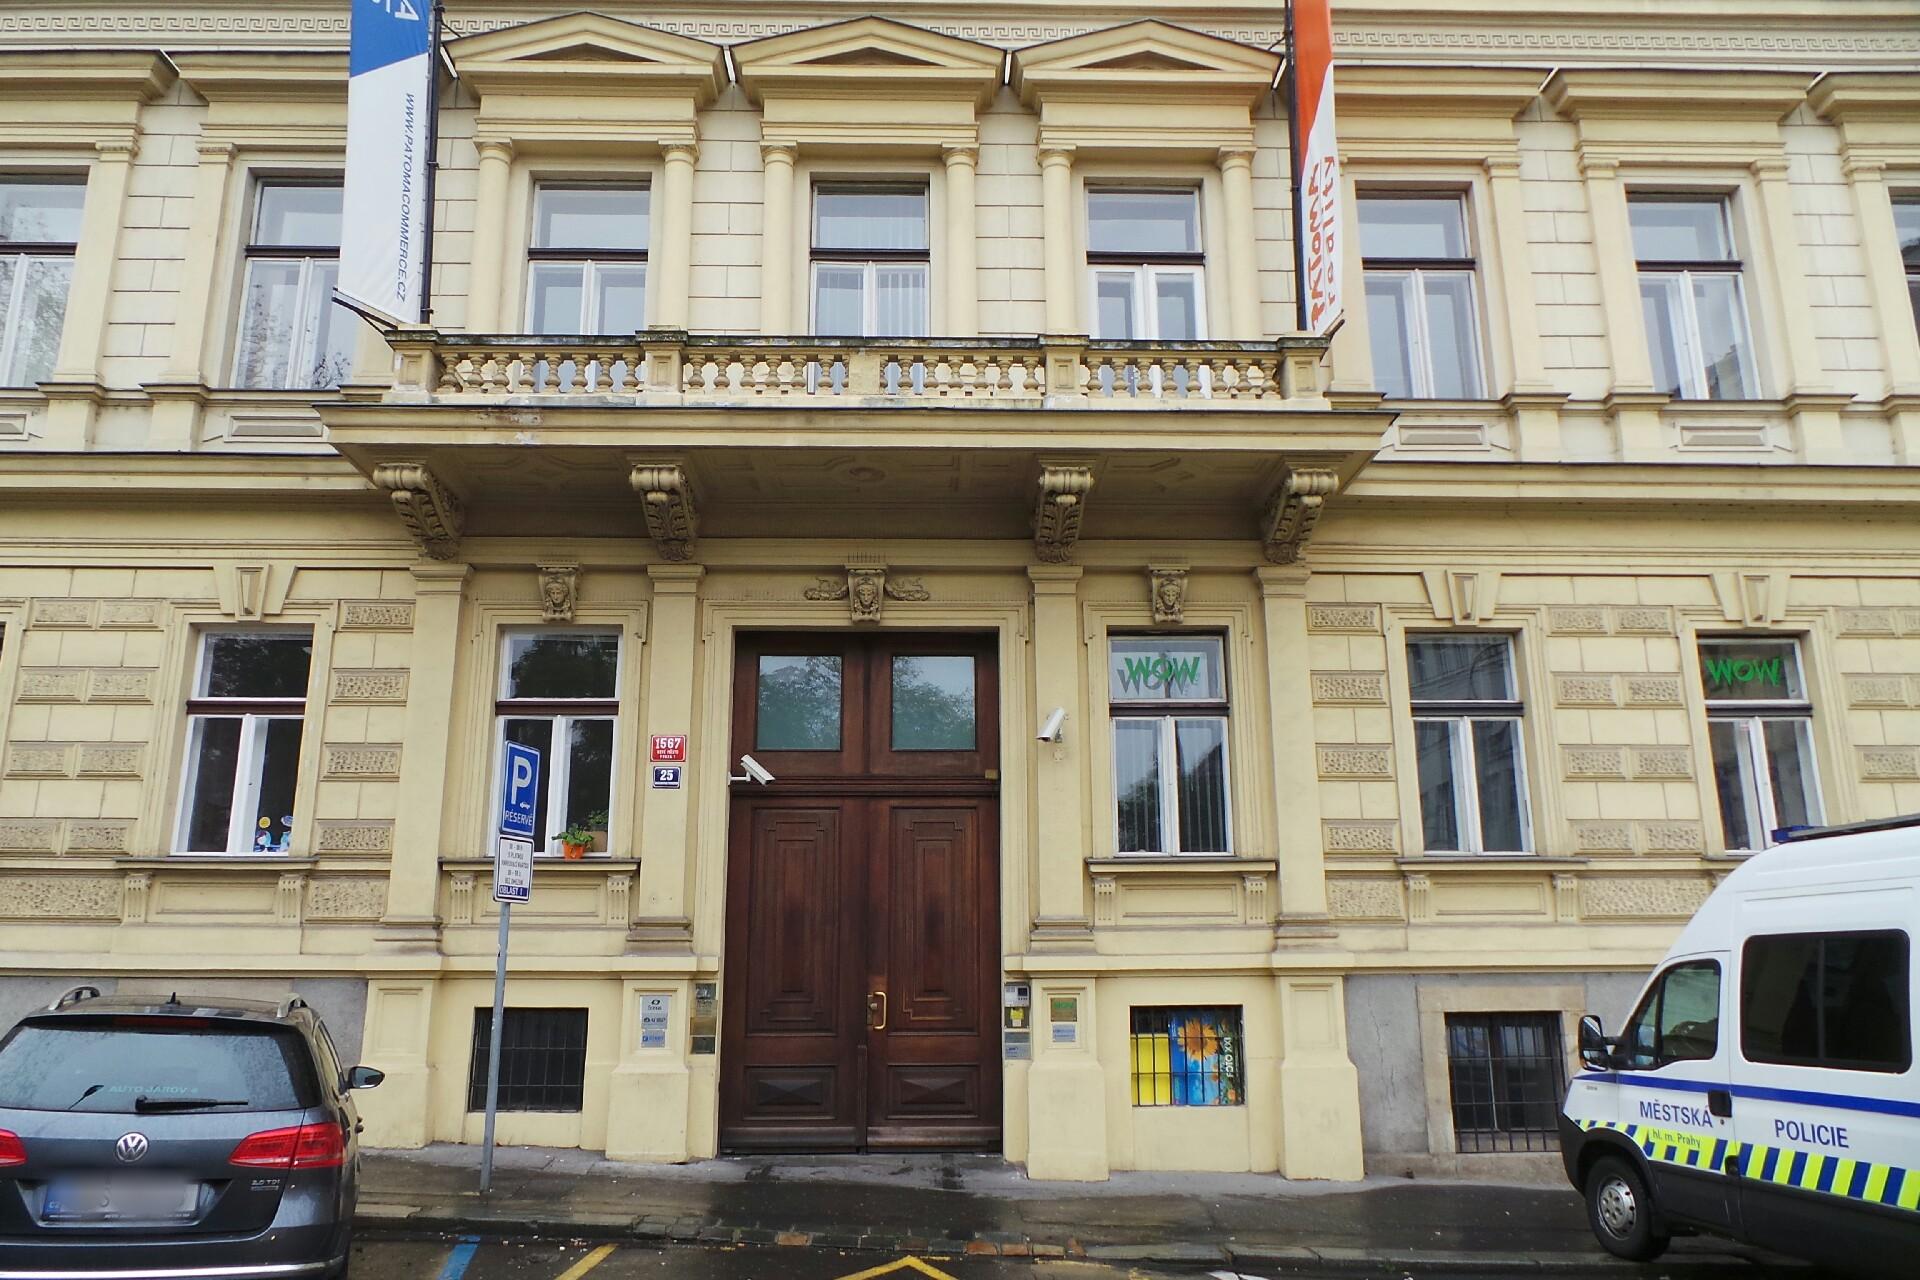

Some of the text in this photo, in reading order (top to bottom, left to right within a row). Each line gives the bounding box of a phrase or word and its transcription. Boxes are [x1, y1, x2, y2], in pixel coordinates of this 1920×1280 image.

[396, 92, 415, 303] WWW.PATOMACOMMERCE.CZ
[1124, 656, 1200, 686] WOW
[1705, 656, 1781, 687] WOW
[655, 737, 682, 750] 1567
[511, 755, 532, 805] P
[659, 769, 674, 781] 25
[504, 808, 533, 827] RÉSERVÉ
[499, 885, 518, 895] OBLAST
[1224, 1054, 1234, 1078] FOTO
[109, 1085, 143, 1093] AUTO
[1639, 1098, 1714, 1128] MĚSTSKÁ
[1652, 1128, 1663, 1139] hl.
[1677, 1132, 1701, 1149] Prahy
[1774, 1118, 1850, 1148] POLICIE
